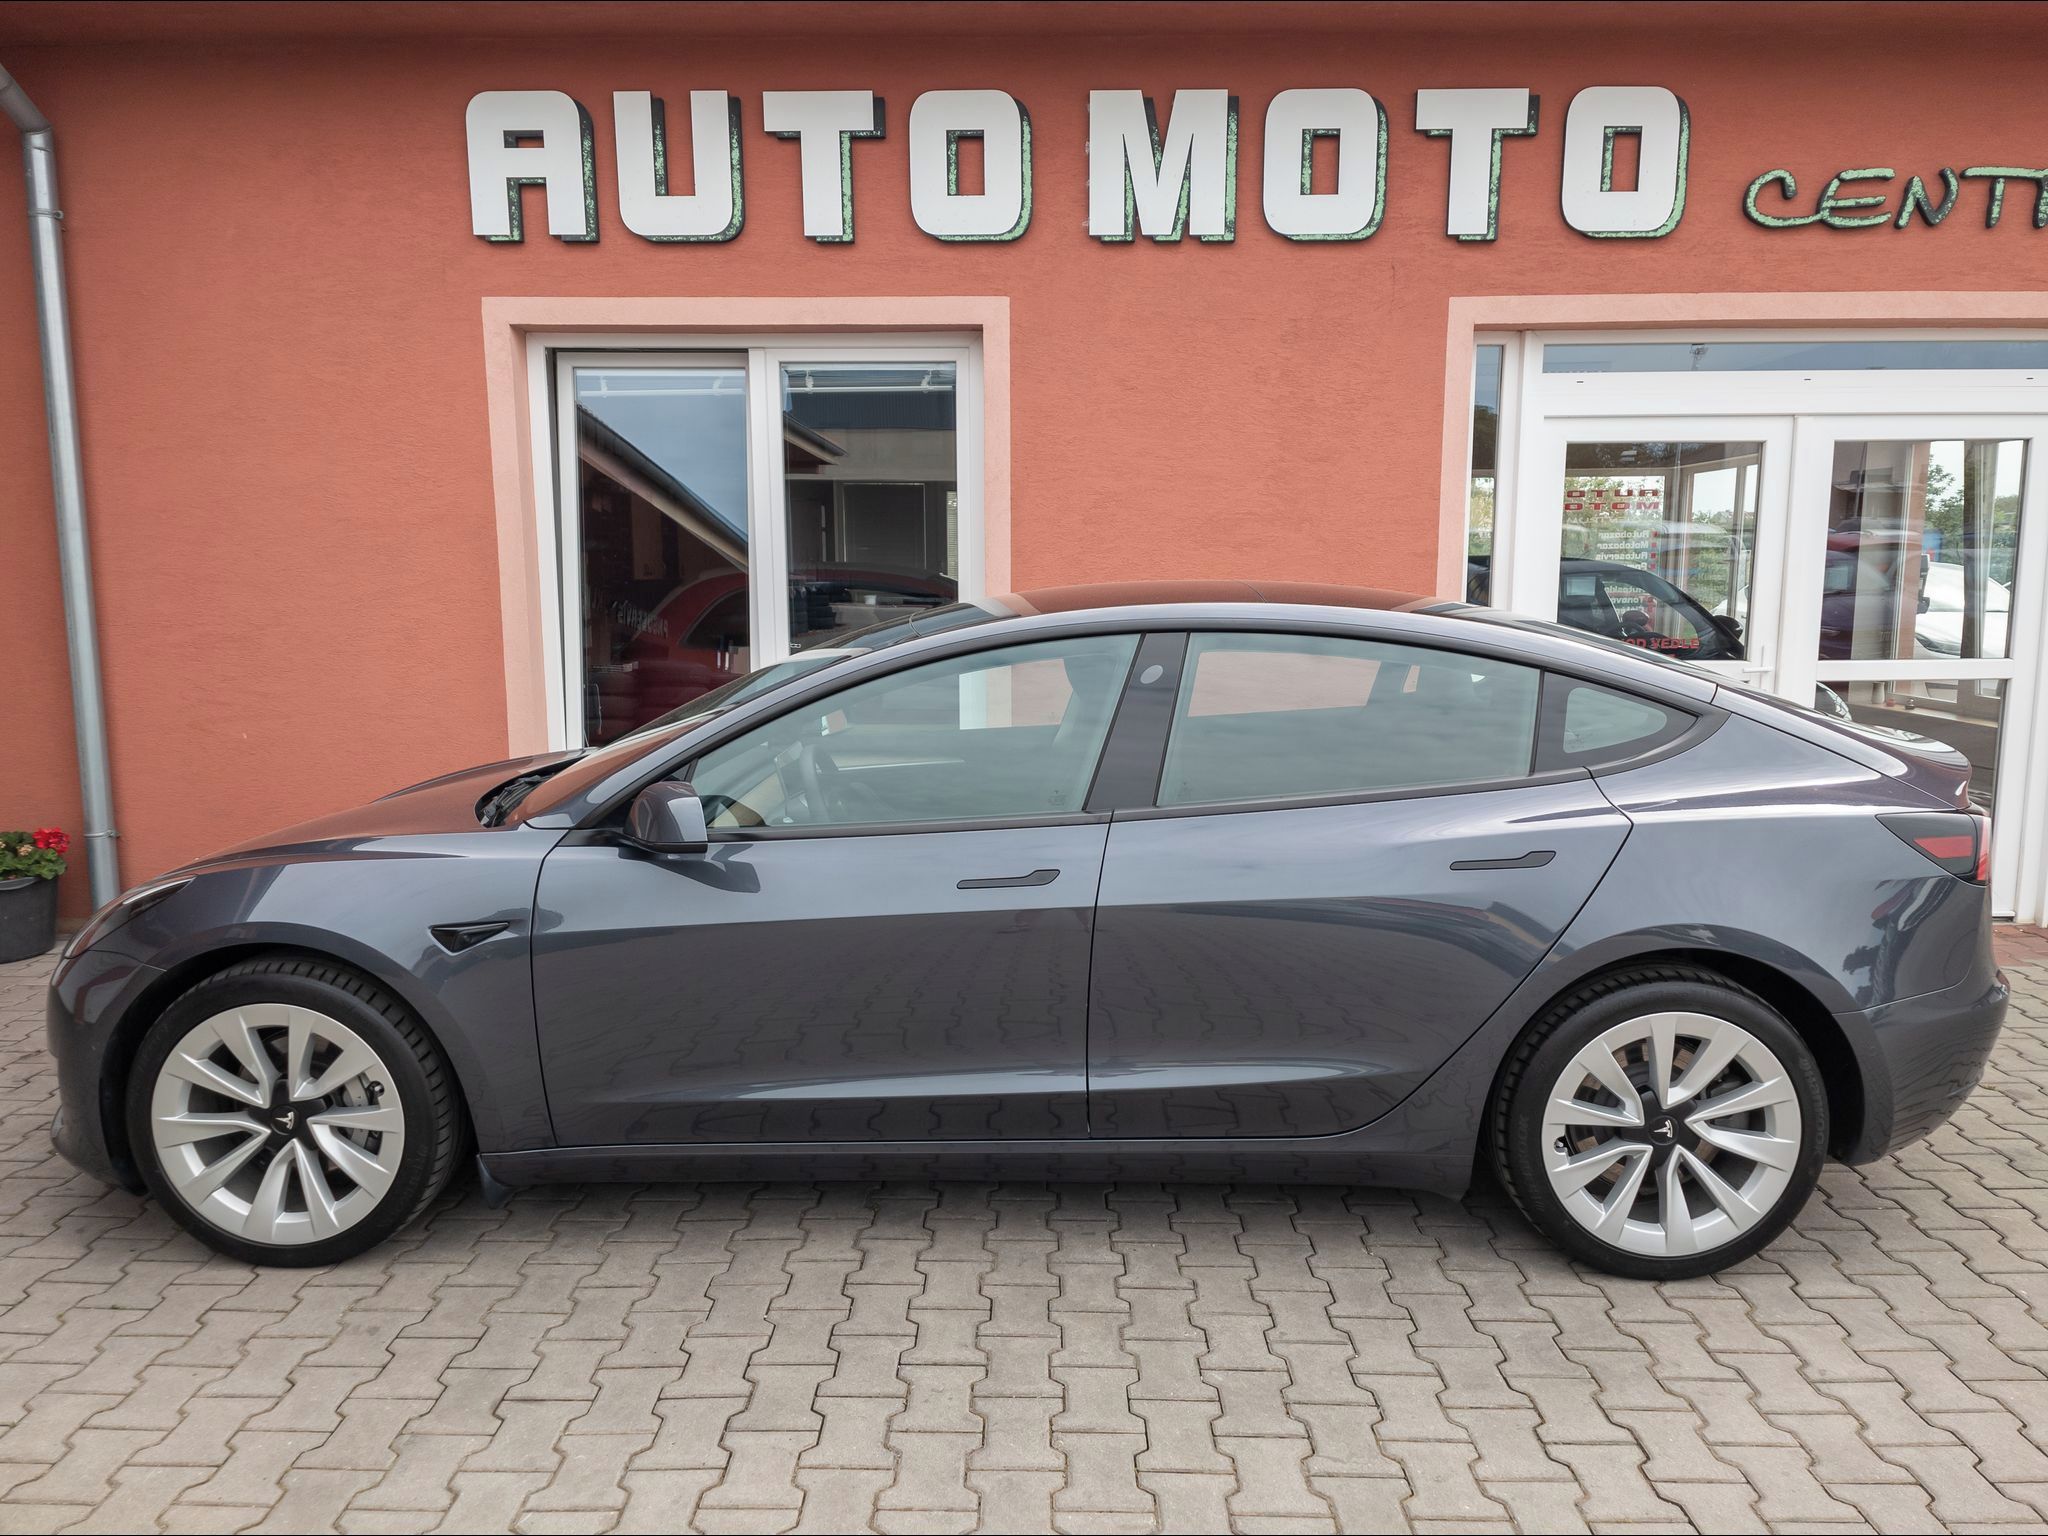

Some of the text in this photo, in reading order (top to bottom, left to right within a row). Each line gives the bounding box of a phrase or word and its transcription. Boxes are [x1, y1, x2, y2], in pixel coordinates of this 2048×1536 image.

[465, 86, 2048, 243] AUTO MOTO CENT
